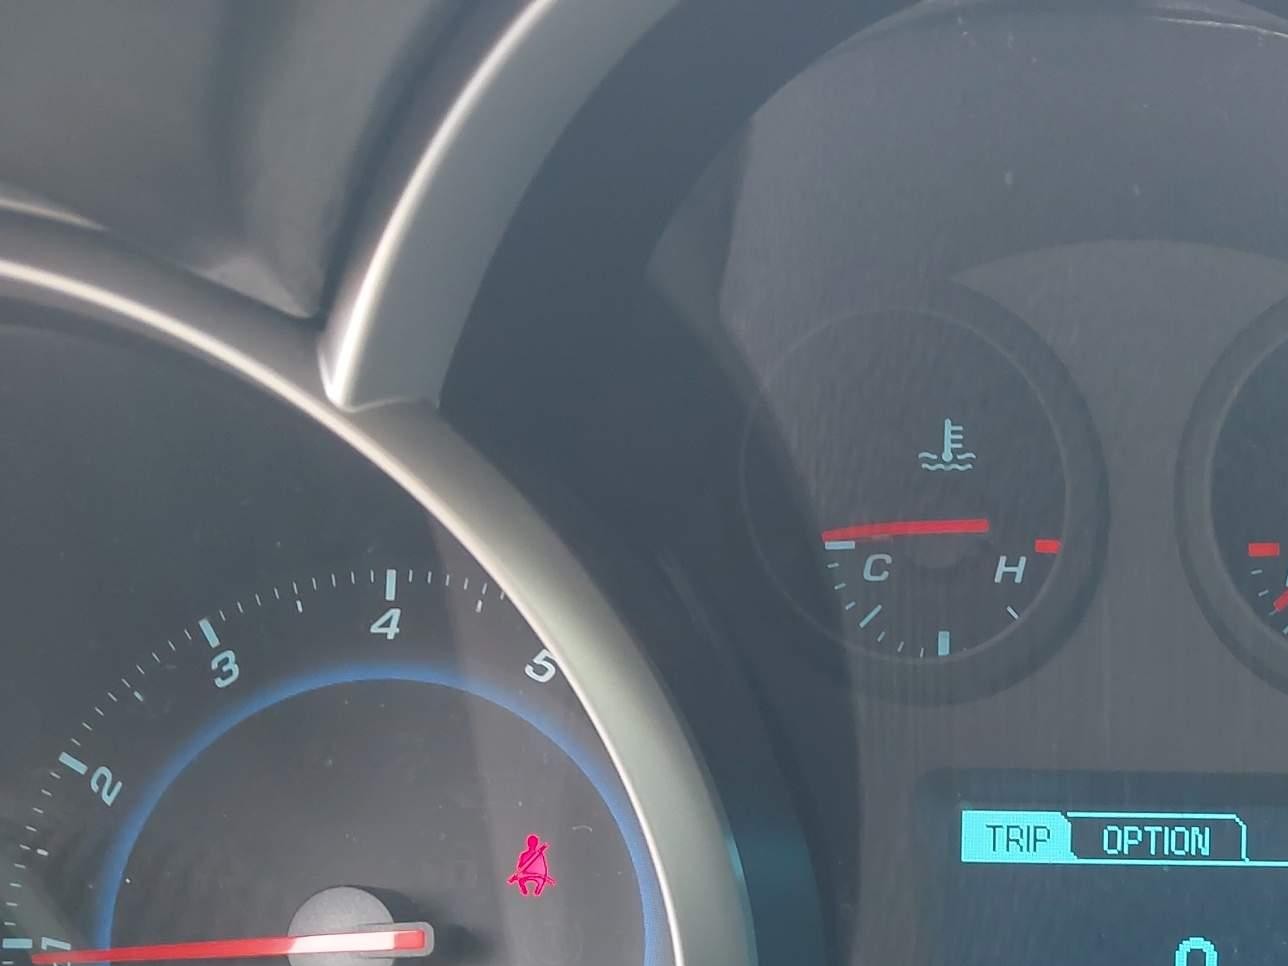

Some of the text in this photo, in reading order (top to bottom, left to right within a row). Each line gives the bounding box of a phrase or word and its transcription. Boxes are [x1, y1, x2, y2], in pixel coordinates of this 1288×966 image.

[863, 554, 893, 583] C
[994, 556, 1028, 584] H
[370, 608, 400, 639] 4
[211, 650, 240, 689] 3
[525, 648, 556, 682] 5
[90, 766, 122, 806] 2
[986, 824, 1210, 857] TRIP OPTION
